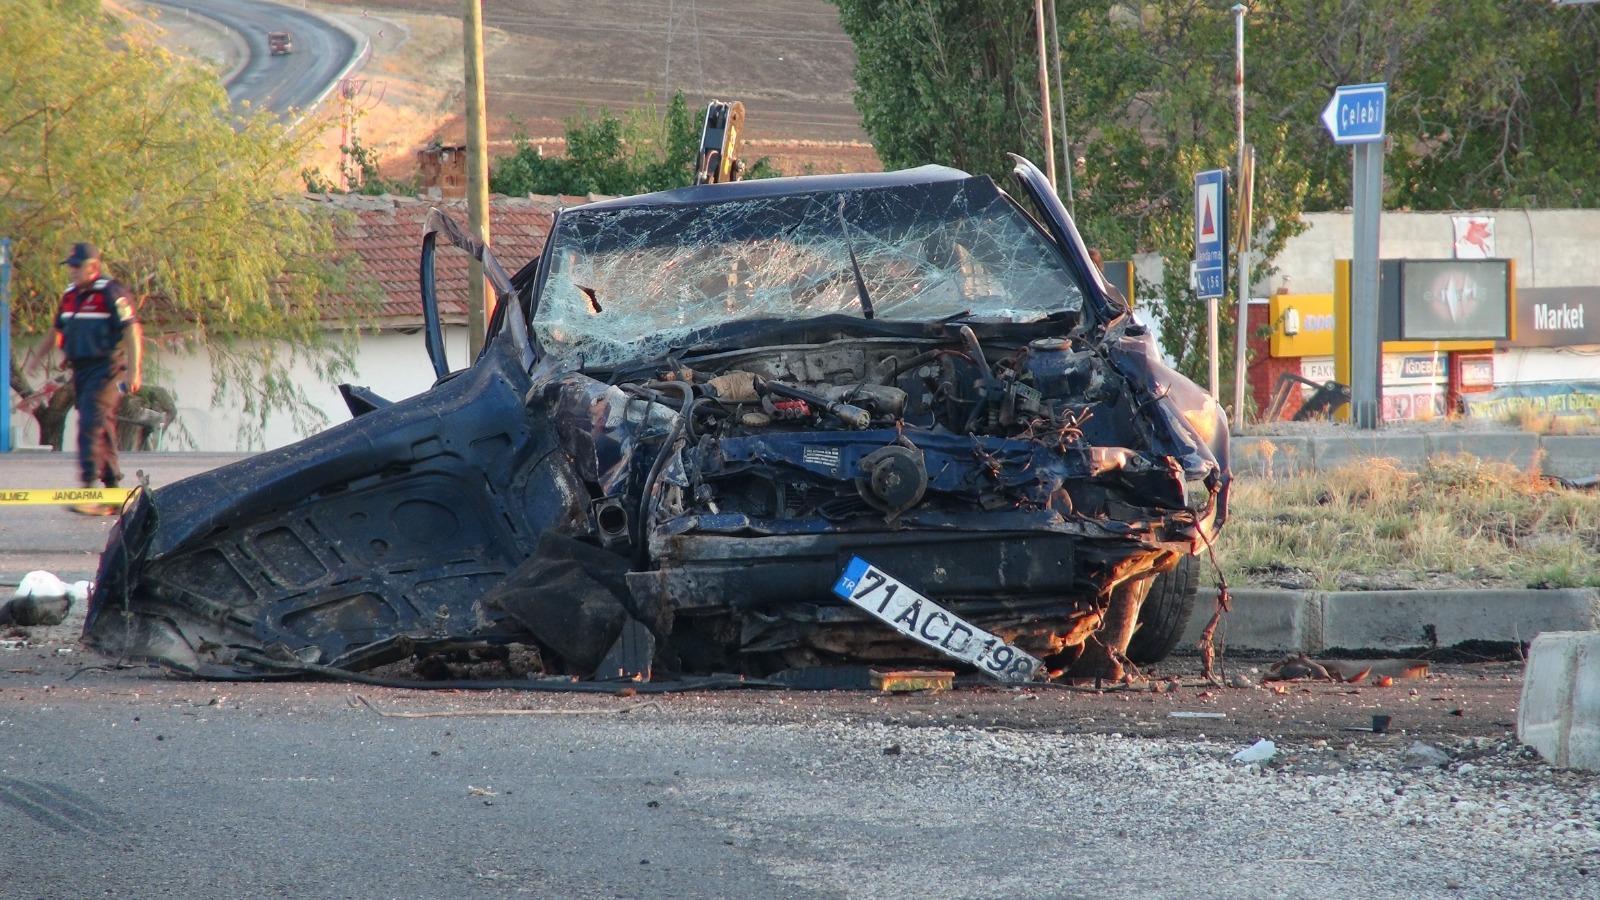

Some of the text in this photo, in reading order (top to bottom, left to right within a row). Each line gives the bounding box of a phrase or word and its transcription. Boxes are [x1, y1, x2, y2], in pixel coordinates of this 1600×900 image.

[1341, 100, 1380, 131] Çelebi
[1206, 275, 1219, 288] 156
[1534, 303, 1584, 330] Market
[52, 491, 103, 501] JANDARMA
[842, 576, 856, 592] TR
[853, 569, 1034, 682] 71 ACD 198
